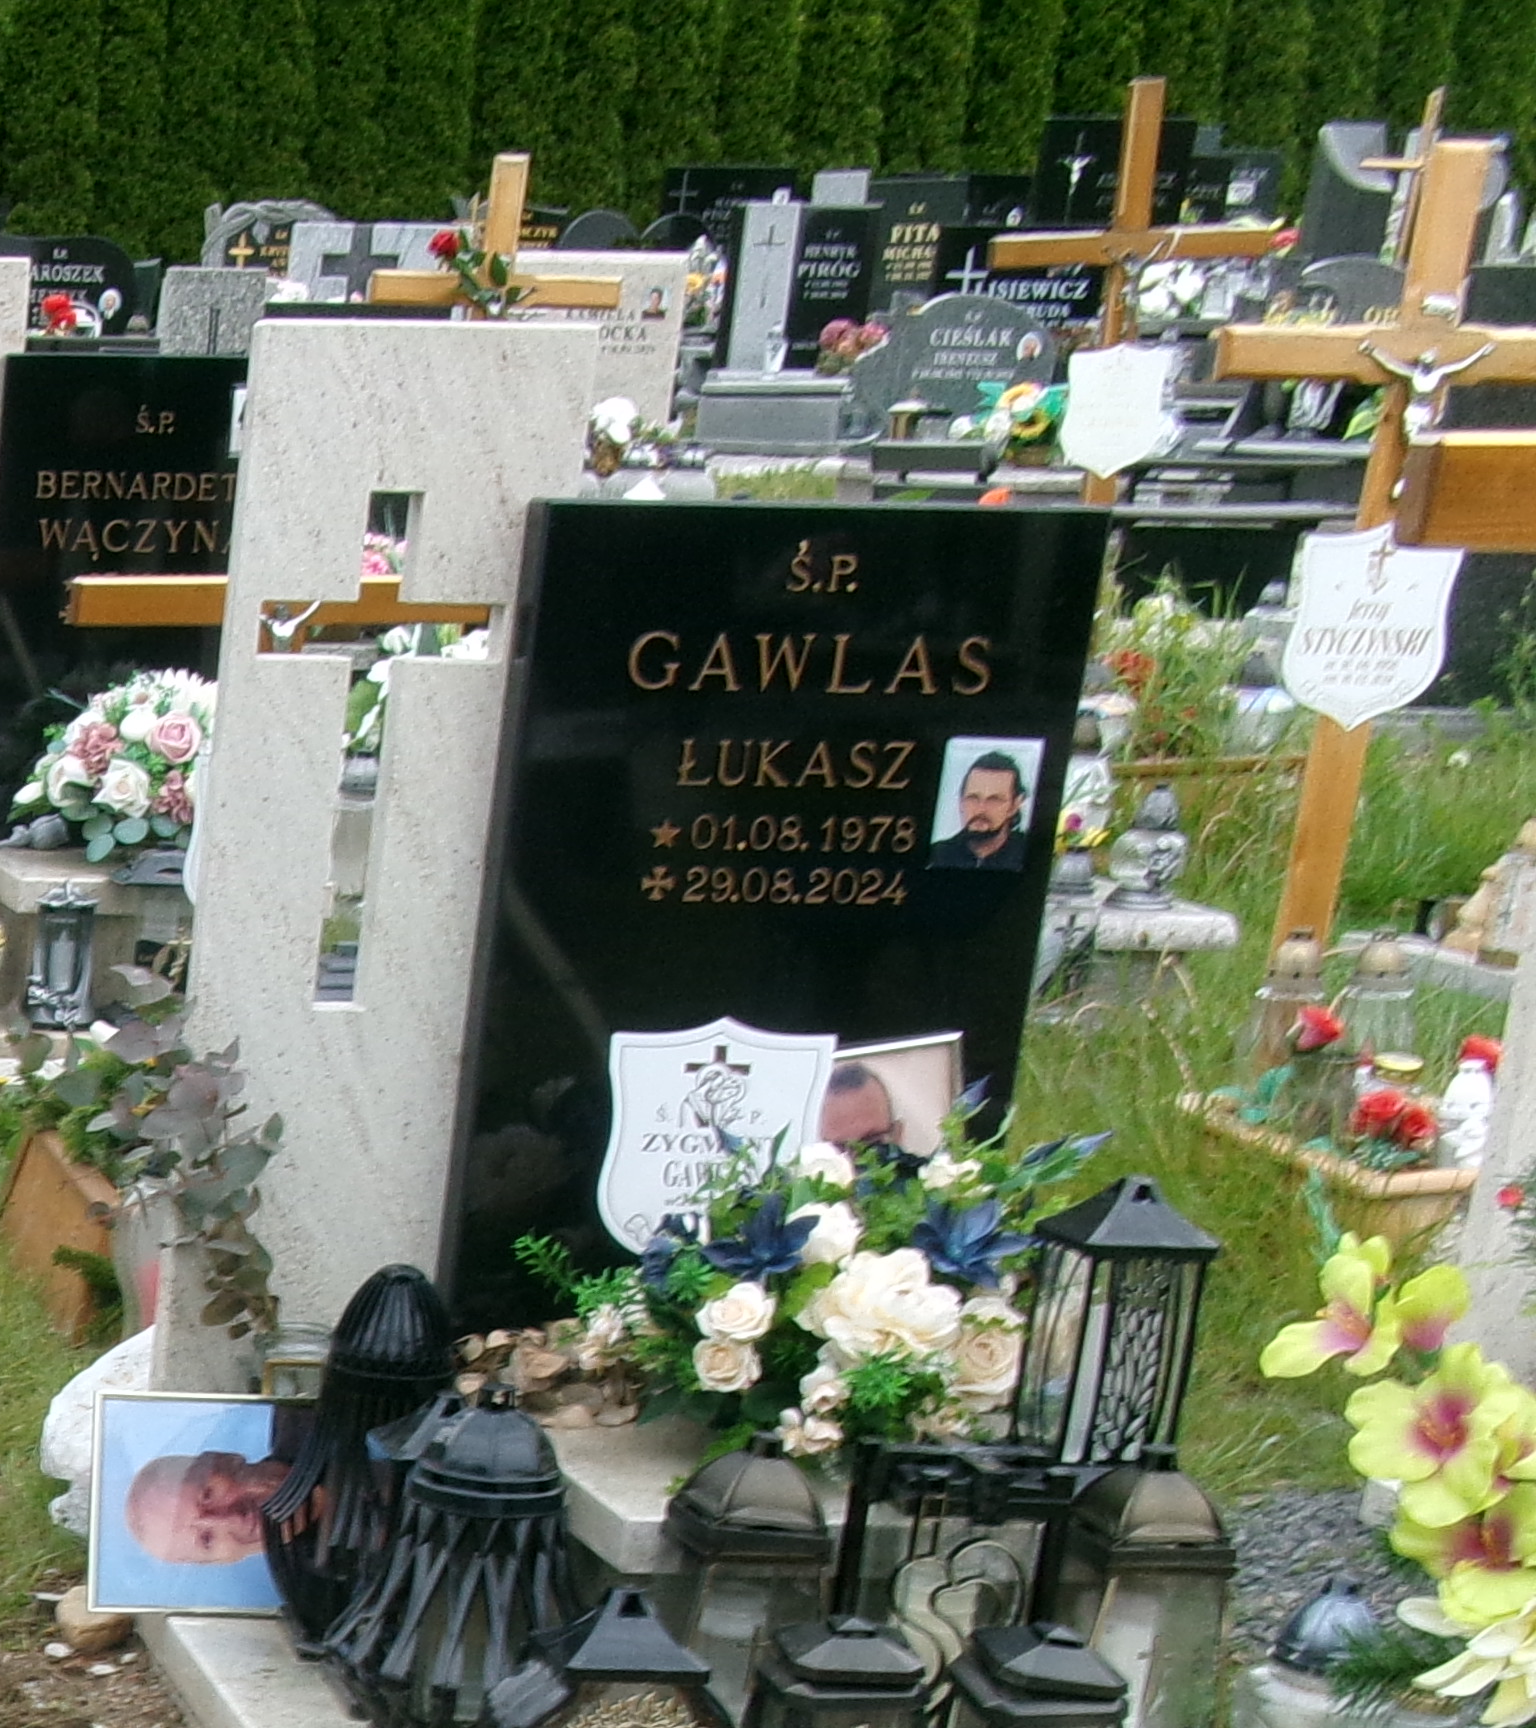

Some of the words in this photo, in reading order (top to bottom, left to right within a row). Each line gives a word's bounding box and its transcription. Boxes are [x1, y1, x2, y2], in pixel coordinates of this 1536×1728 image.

[29, 264, 104, 283] AROSZEK
[135, 404, 176, 434] Ś.P.
[36, 470, 237, 501] BERNARDET
[38, 518, 232, 562] WĄCZYN
[786, 538, 860, 593] Ś.P.
[628, 630, 993, 695] GAWLAS
[676, 738, 917, 790] ŁUKASZ
[691, 813, 918, 853] 01.08.1978
[682, 865, 909, 905] 29.08.2024
